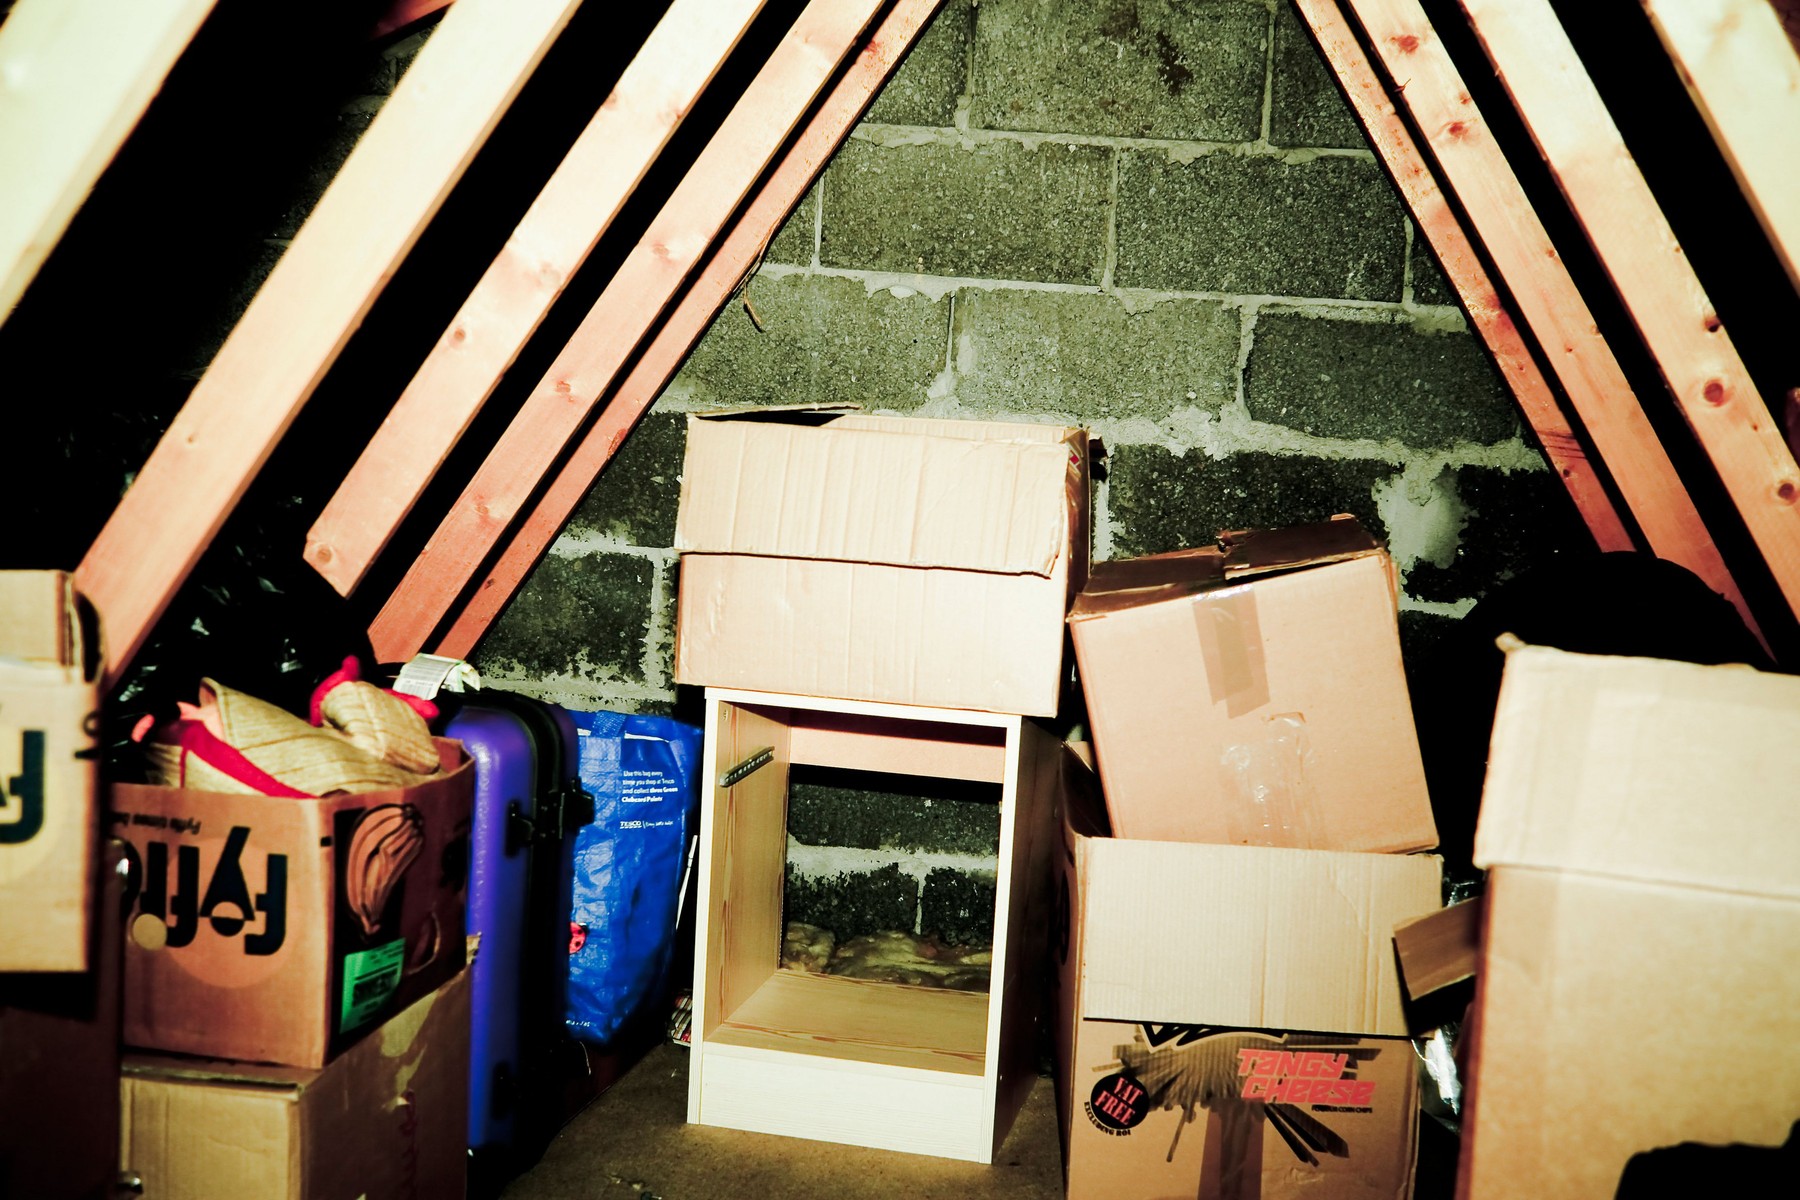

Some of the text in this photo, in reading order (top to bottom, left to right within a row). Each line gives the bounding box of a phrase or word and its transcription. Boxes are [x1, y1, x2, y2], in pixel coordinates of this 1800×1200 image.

[620, 820, 642, 829] TESCO
[1113, 1077, 1144, 1106] VAT
[1094, 1090, 1136, 1126] FREE
